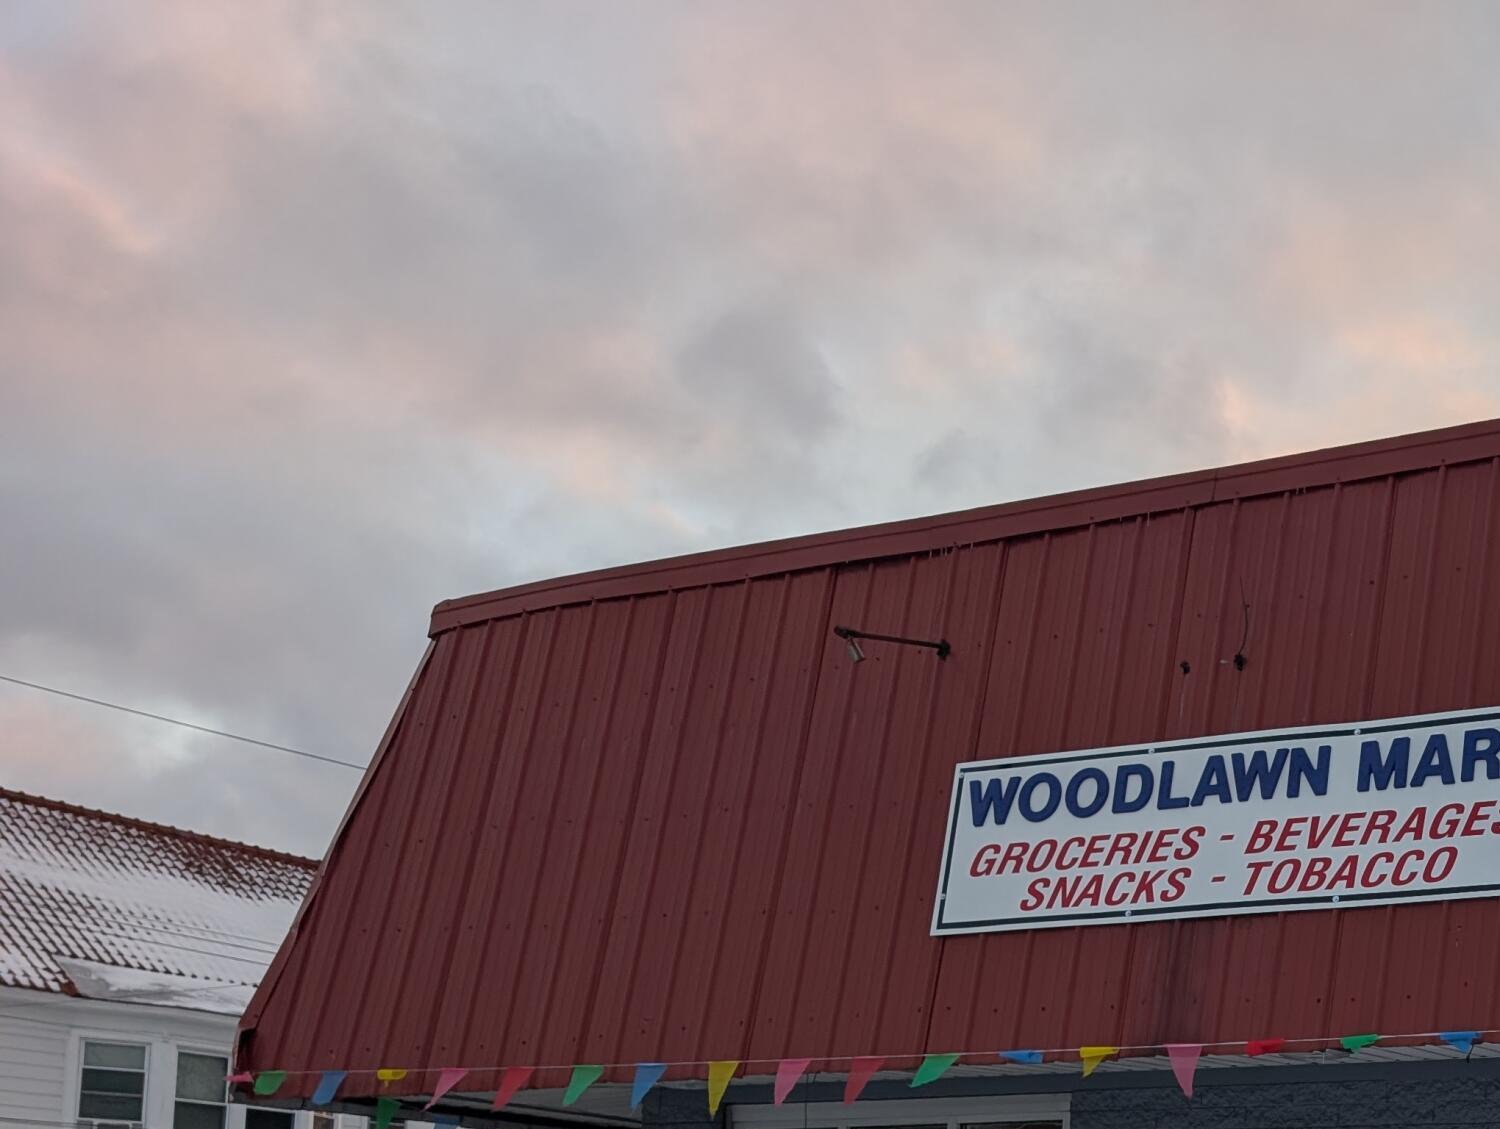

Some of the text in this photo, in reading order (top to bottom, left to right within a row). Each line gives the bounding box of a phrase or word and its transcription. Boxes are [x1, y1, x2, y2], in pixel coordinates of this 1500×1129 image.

[968, 744, 1332, 828] WOODLAWN
[968, 826, 1206, 878] GROCERIES
[1019, 866, 1193, 912] SNACKS
[1241, 846, 1459, 896] TOBACCO
